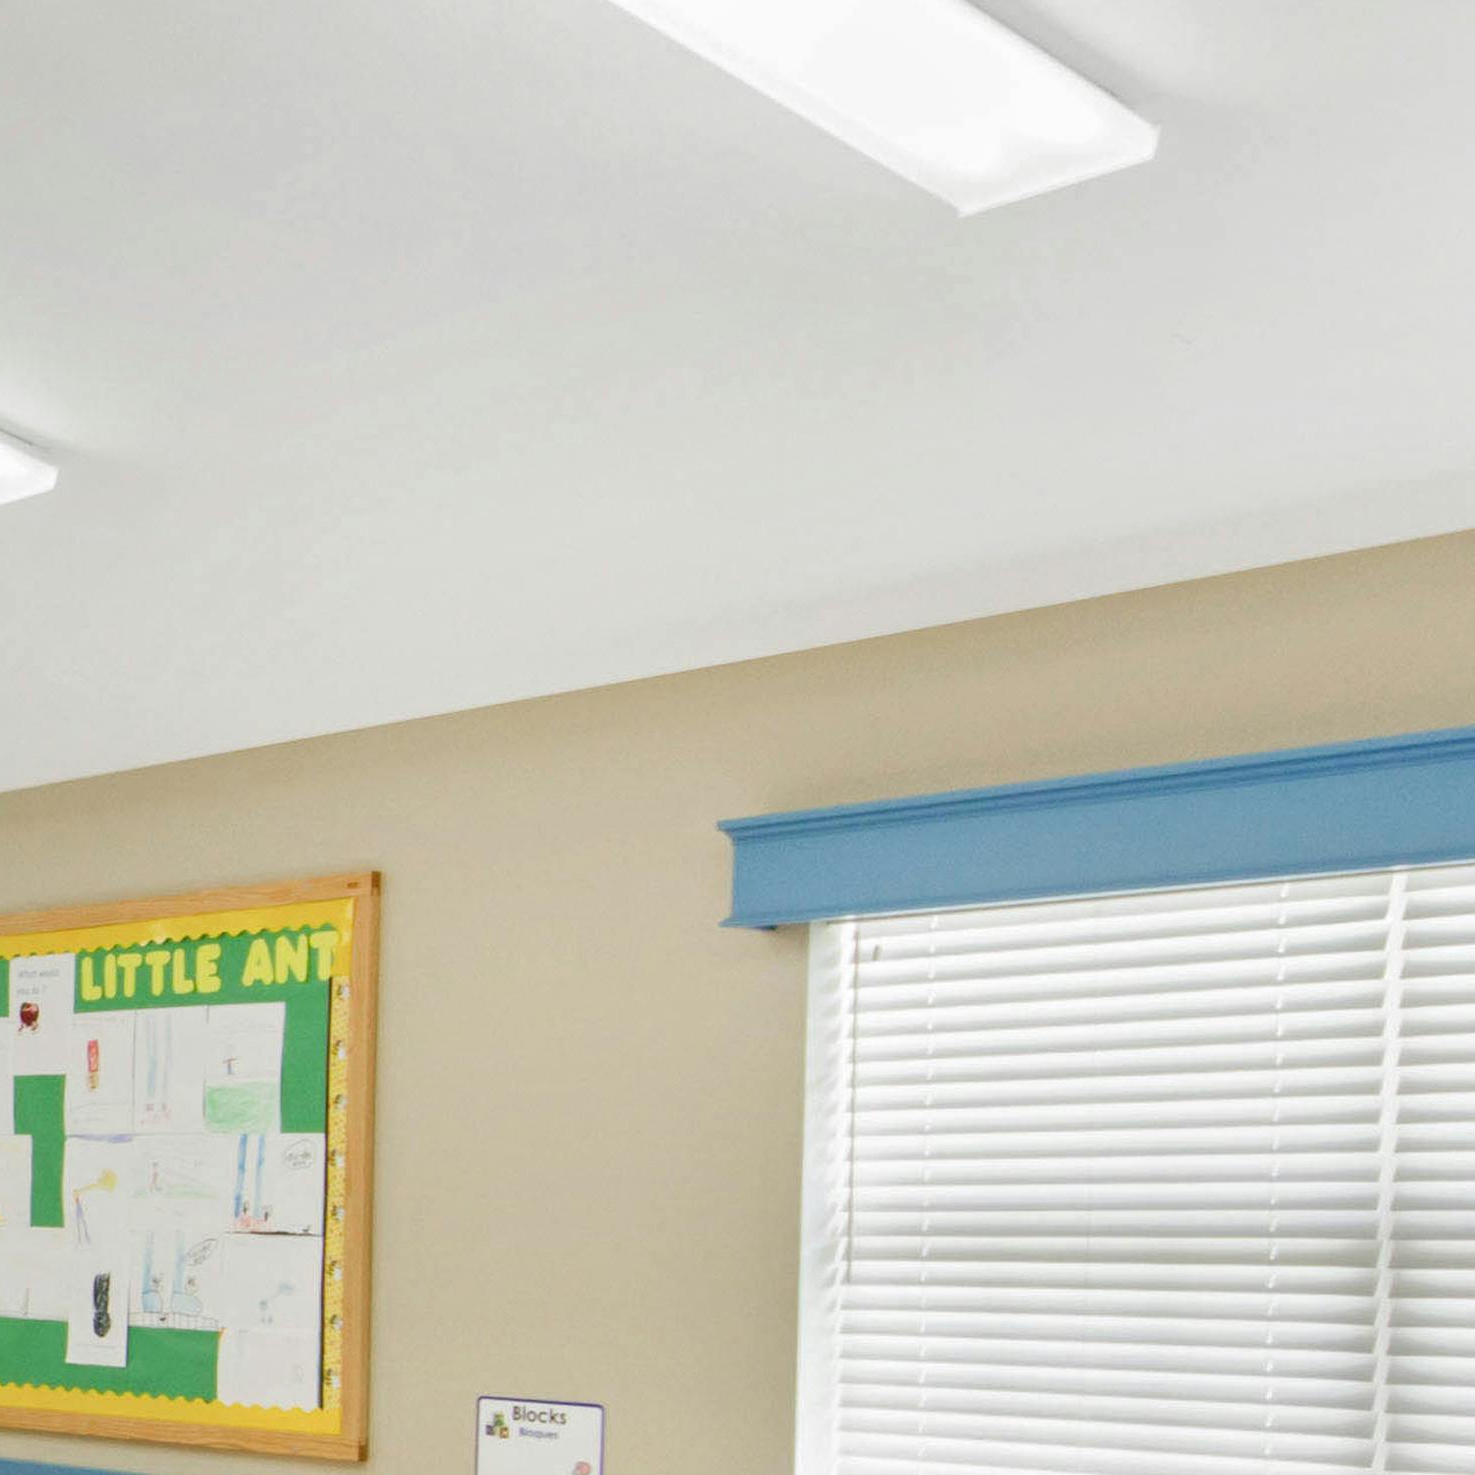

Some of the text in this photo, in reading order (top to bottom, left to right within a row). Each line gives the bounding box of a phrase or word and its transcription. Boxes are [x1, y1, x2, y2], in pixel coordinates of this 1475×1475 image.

[81, 943, 223, 1001] LITTLE
[240, 930, 340, 988] ANT
[512, 1405, 568, 1425] Blocks
